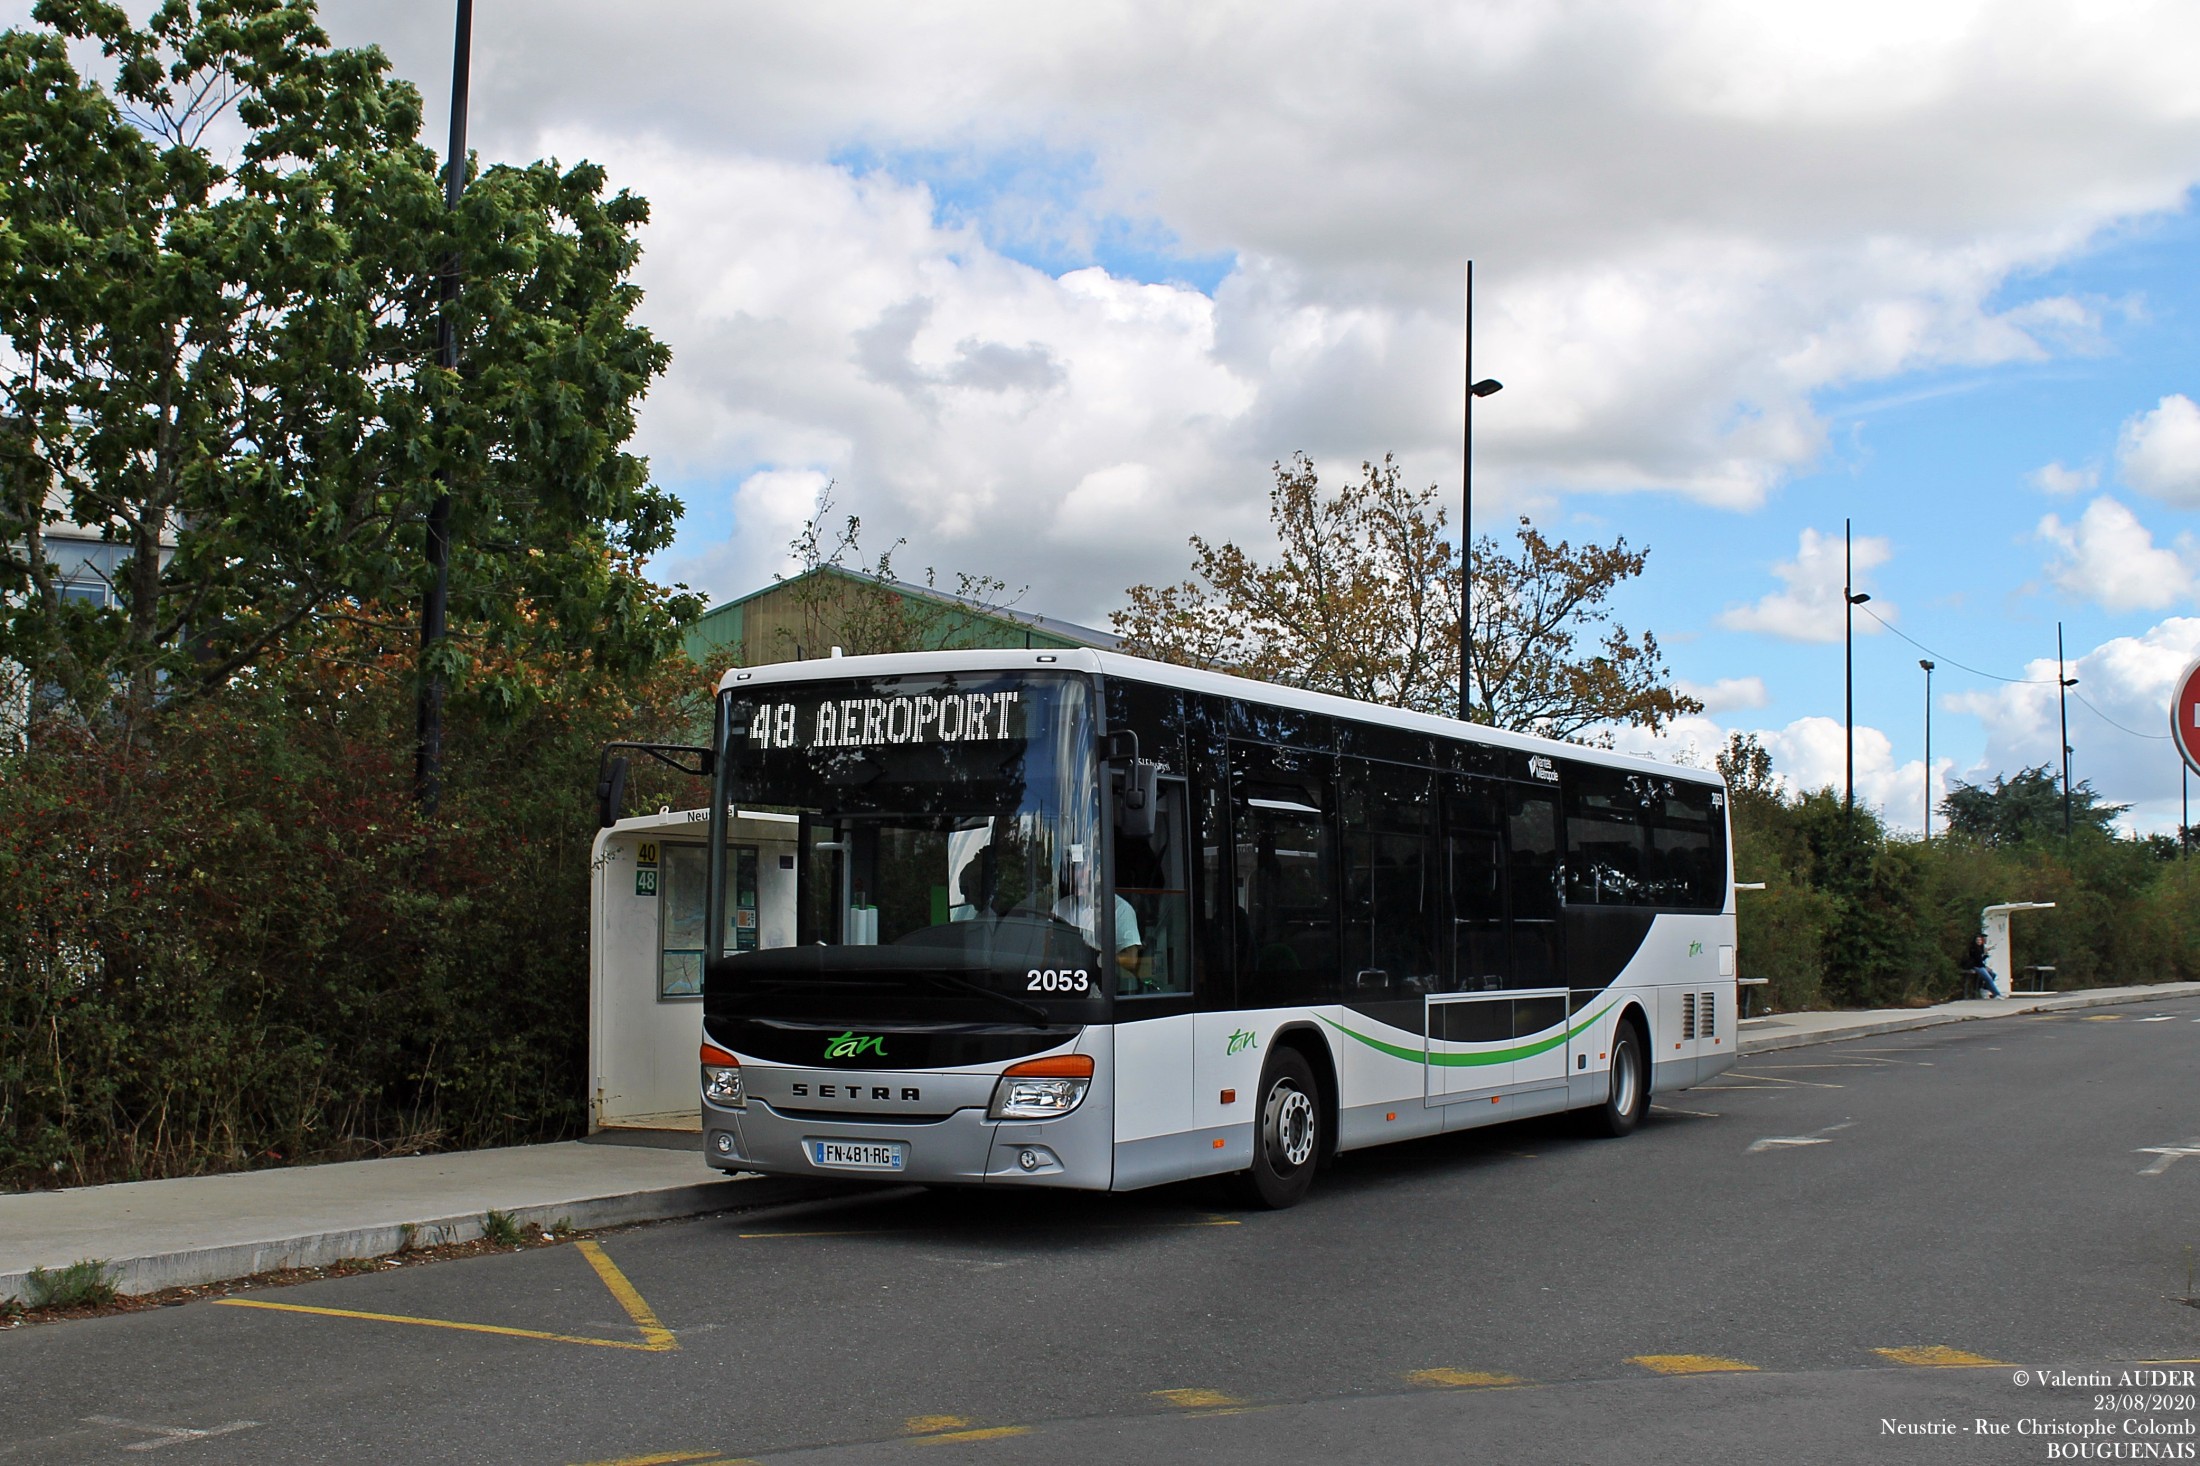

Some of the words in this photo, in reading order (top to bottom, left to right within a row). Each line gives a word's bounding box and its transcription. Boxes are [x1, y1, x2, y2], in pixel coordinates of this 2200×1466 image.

[750, 703, 796, 749] 48
[813, 691, 1018, 747] AEROPORT
[639, 844, 655, 861] 40
[638, 872, 655, 890] 48
[1027, 969, 1089, 992] 2053
[824, 1031, 888, 1059] tan
[1227, 1028, 1258, 1055] tan
[792, 1083, 920, 1101] SETRA
[826, 1145, 890, 1164] FN-481-RG
